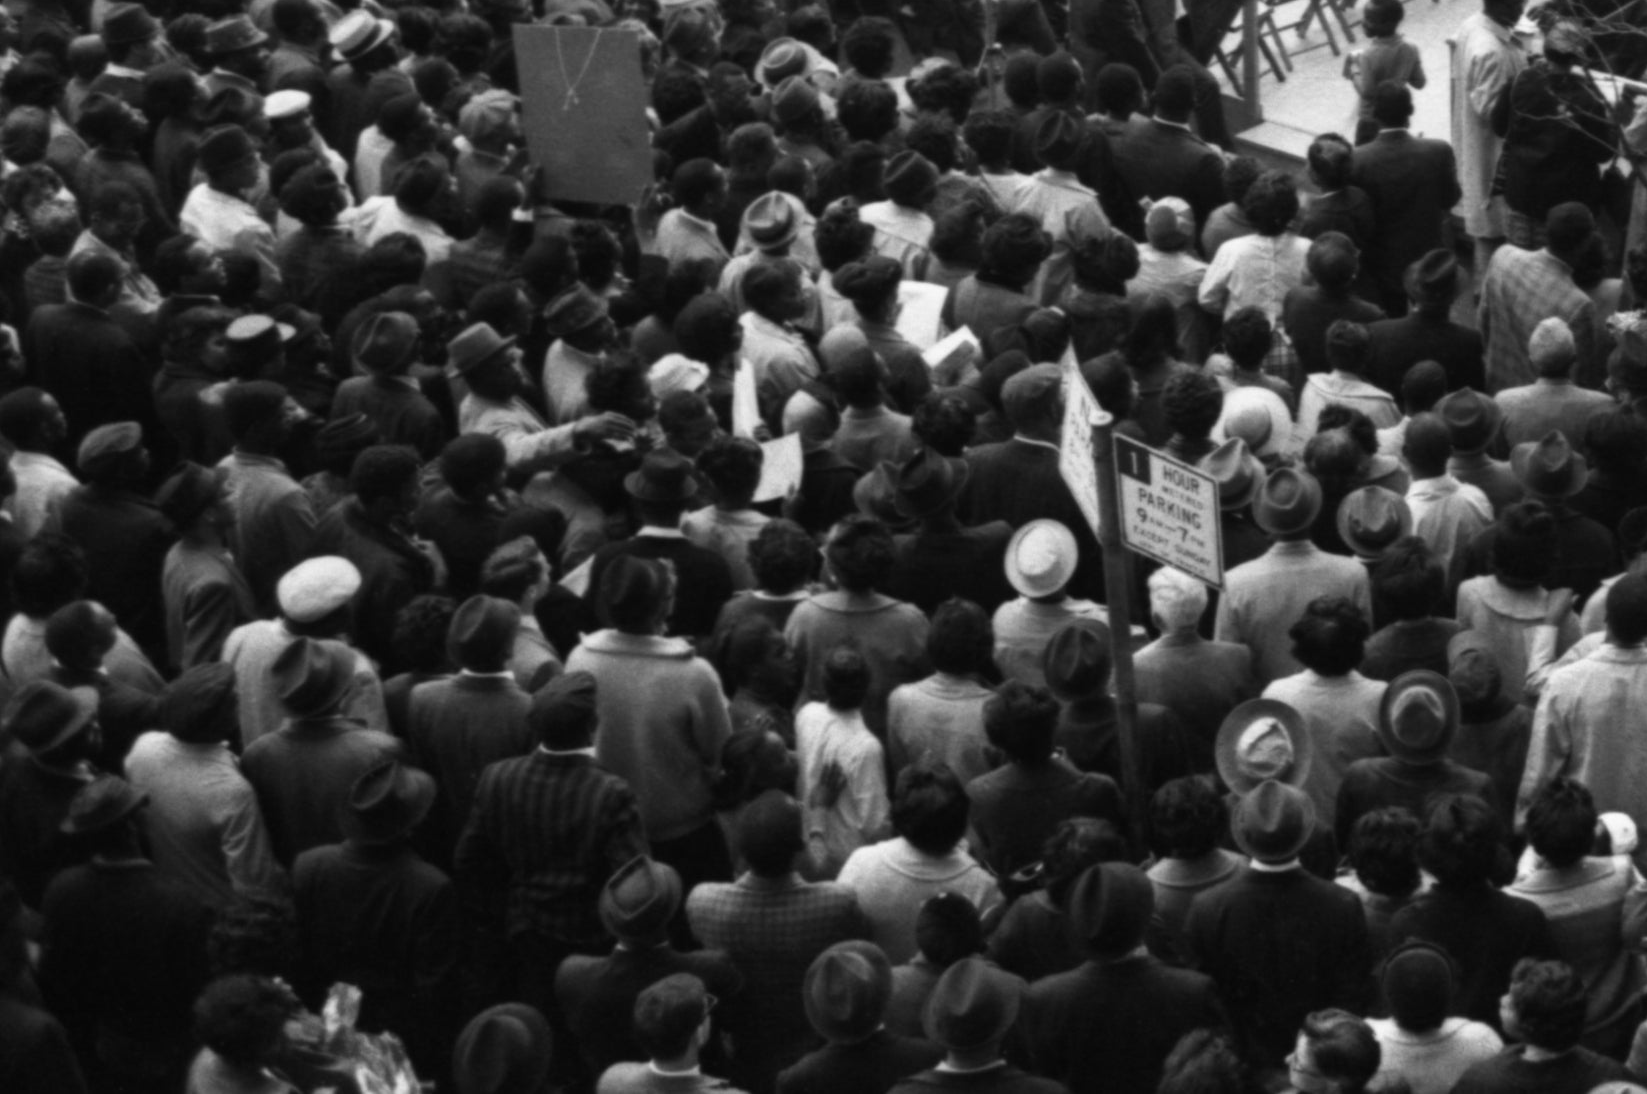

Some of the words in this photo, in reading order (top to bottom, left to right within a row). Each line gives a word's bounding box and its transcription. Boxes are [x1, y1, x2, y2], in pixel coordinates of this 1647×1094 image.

[1129, 450, 1138, 476] 1
[1162, 465, 1200, 495] HOUR
[1138, 486, 1202, 531] PARKING
